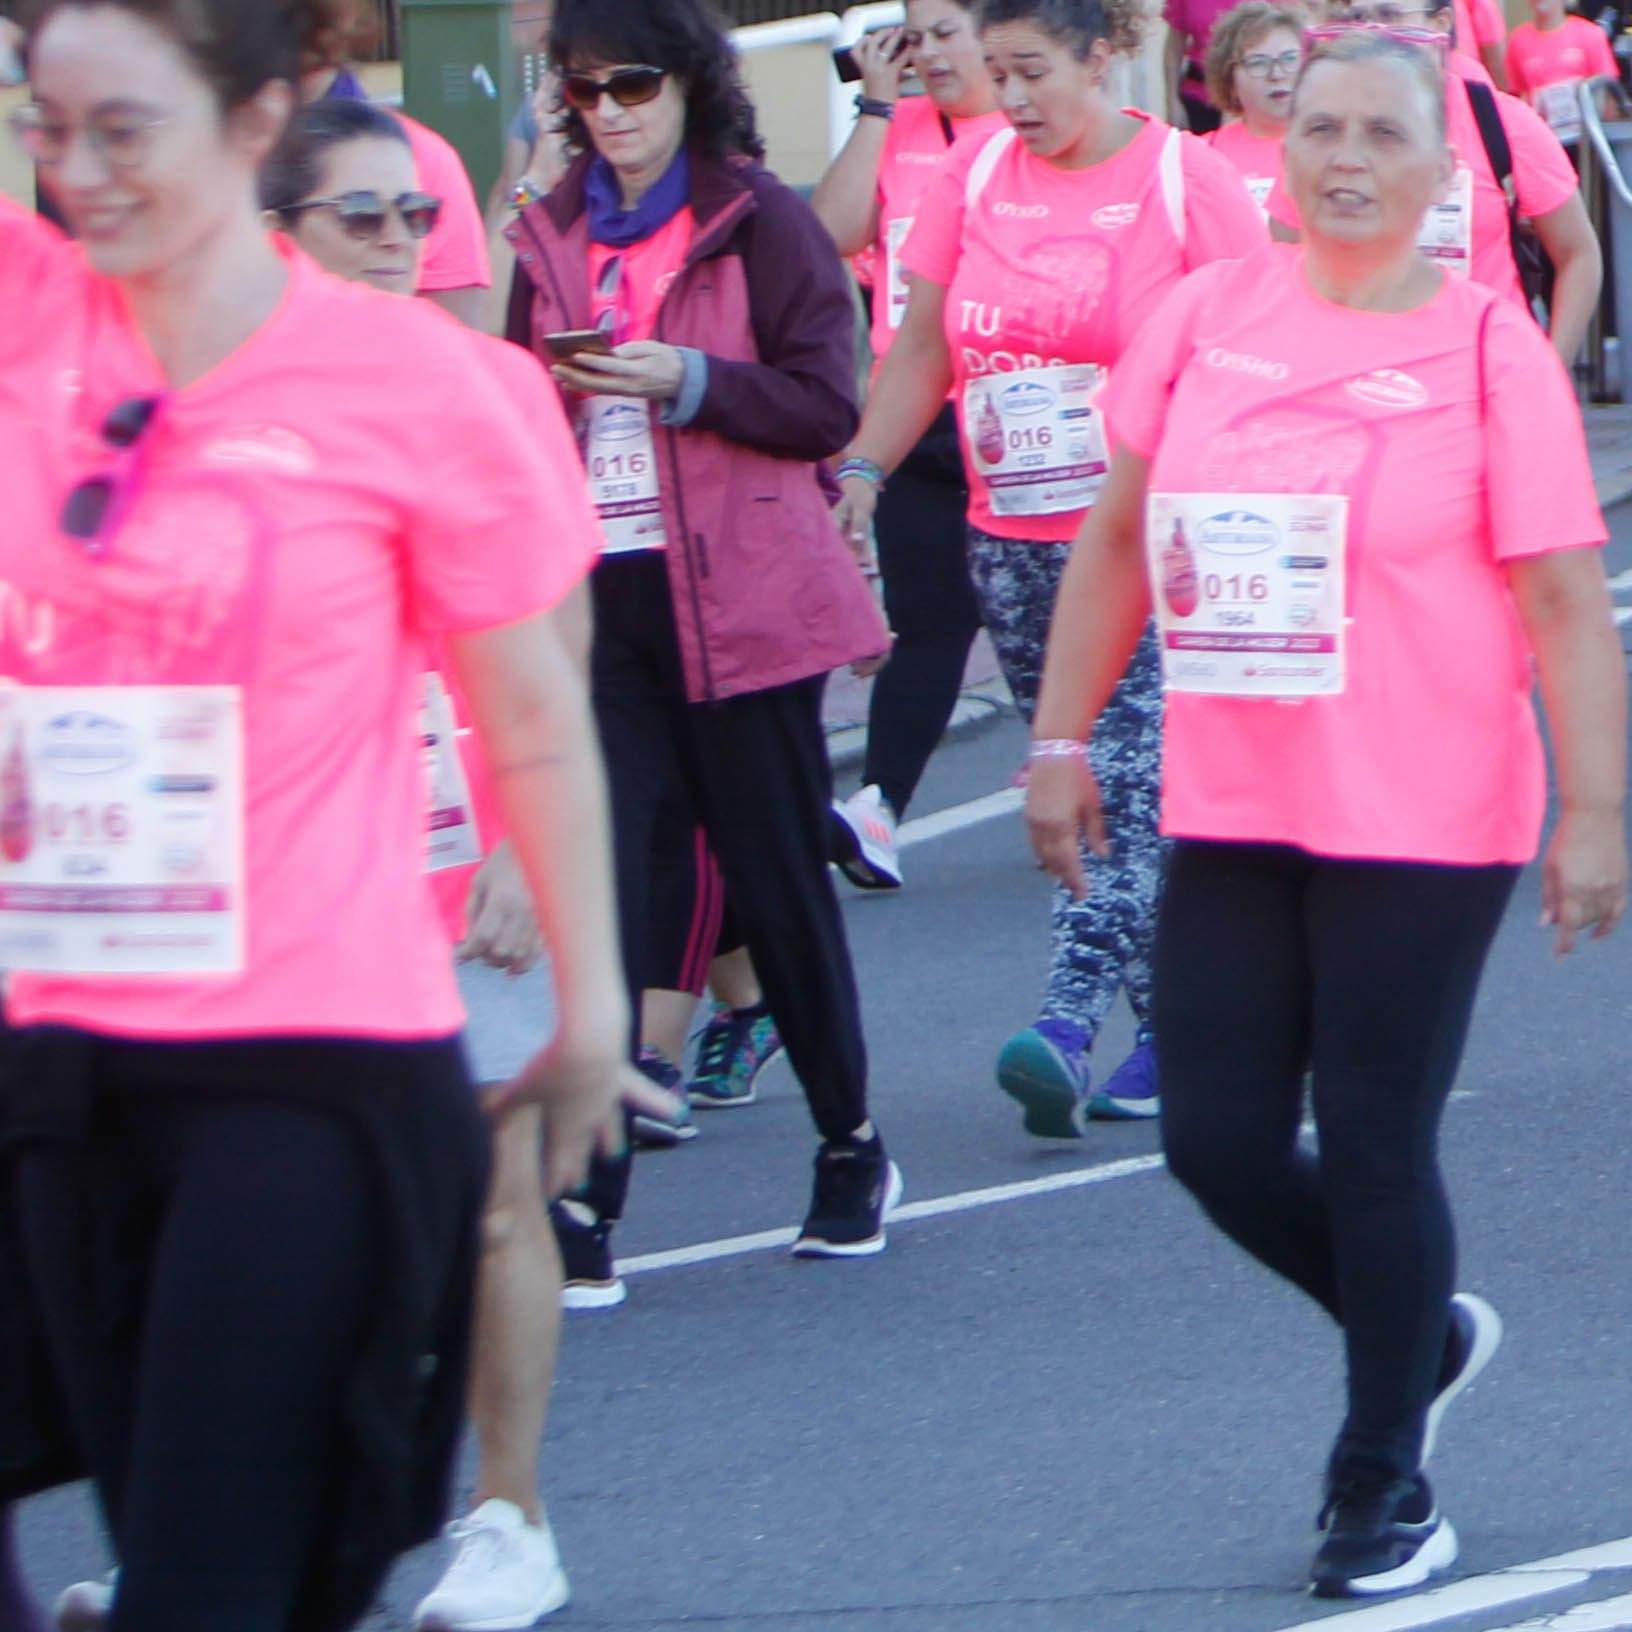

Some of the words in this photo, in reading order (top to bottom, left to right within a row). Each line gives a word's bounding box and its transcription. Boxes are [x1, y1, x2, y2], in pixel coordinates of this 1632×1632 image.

[961, 300, 1001, 337] TU
[1009, 426, 1053, 449] 016
[593, 453, 646, 478] 016
[1205, 573, 1269, 600] 016
[46, 801, 130, 840] 016
